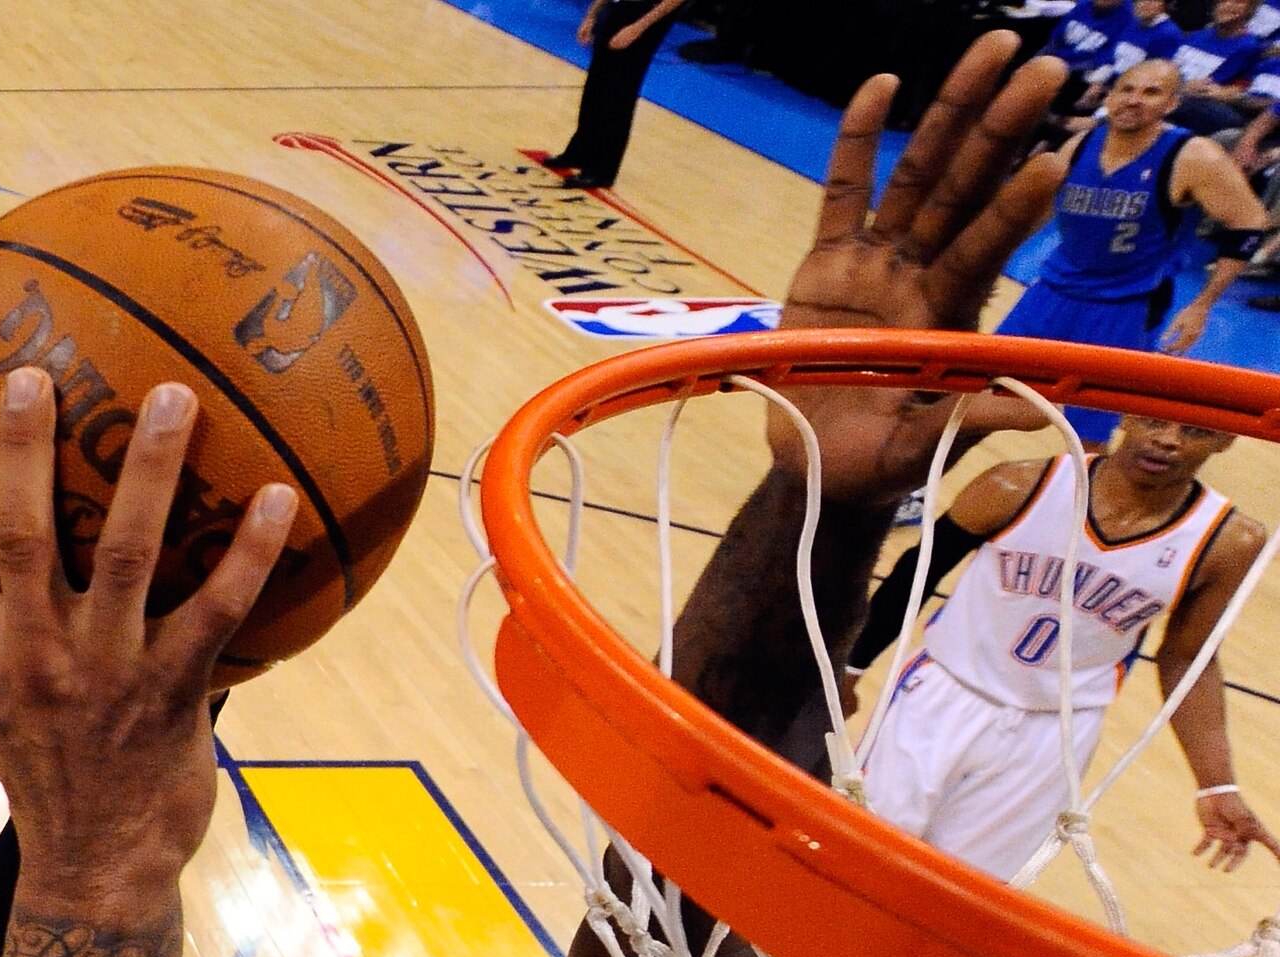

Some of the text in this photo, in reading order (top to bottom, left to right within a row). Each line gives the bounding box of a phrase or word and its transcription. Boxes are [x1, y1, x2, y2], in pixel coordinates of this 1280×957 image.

[353, 139, 622, 295] WESTERN
[428, 144, 681, 294] CONFERENCE
[1111, 222, 1140, 253] 2
[1010, 613, 1063, 667] 0
